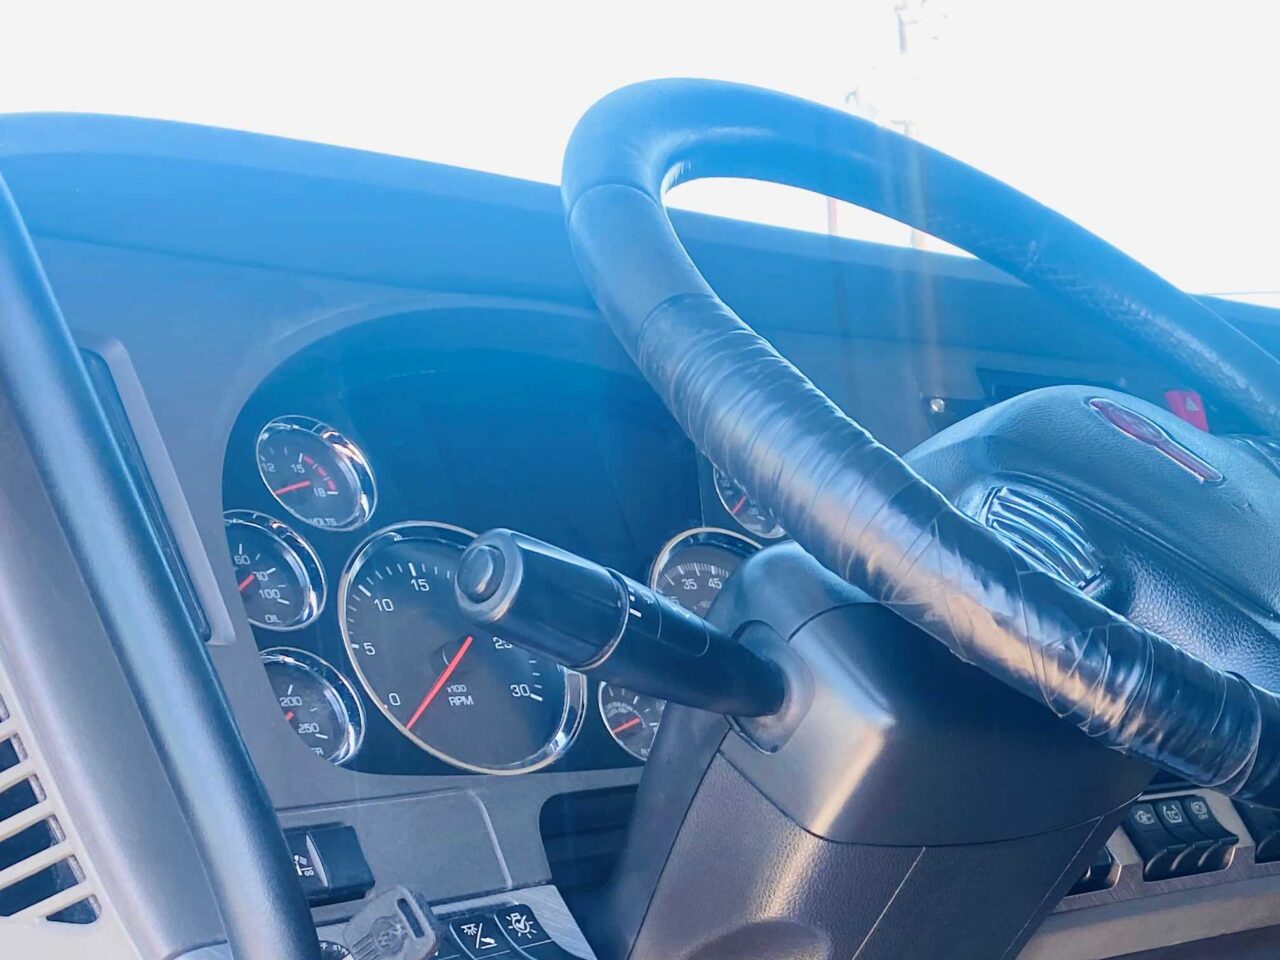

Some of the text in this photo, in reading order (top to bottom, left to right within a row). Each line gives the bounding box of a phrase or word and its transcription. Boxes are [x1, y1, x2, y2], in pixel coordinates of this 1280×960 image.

[261, 463, 275, 473] 12
[291, 464, 305, 474] 15
[313, 487, 327, 498] 18
[234, 555, 251, 565] 60
[410, 578, 430, 592] 15
[681, 578, 698, 590] 35
[708, 577, 722, 589] 45
[259, 588, 280, 599] 100
[373, 598, 394, 612] 10
[265, 614, 281, 623] OIL
[363, 642, 376, 656] 5
[510, 684, 530, 697] 30
[280, 696, 303, 707] 200
[389, 693, 401, 706] 0
[449, 695, 474, 706] RPM
[298, 723, 320, 734] 250
[1167, 810, 1179, 820] TC
